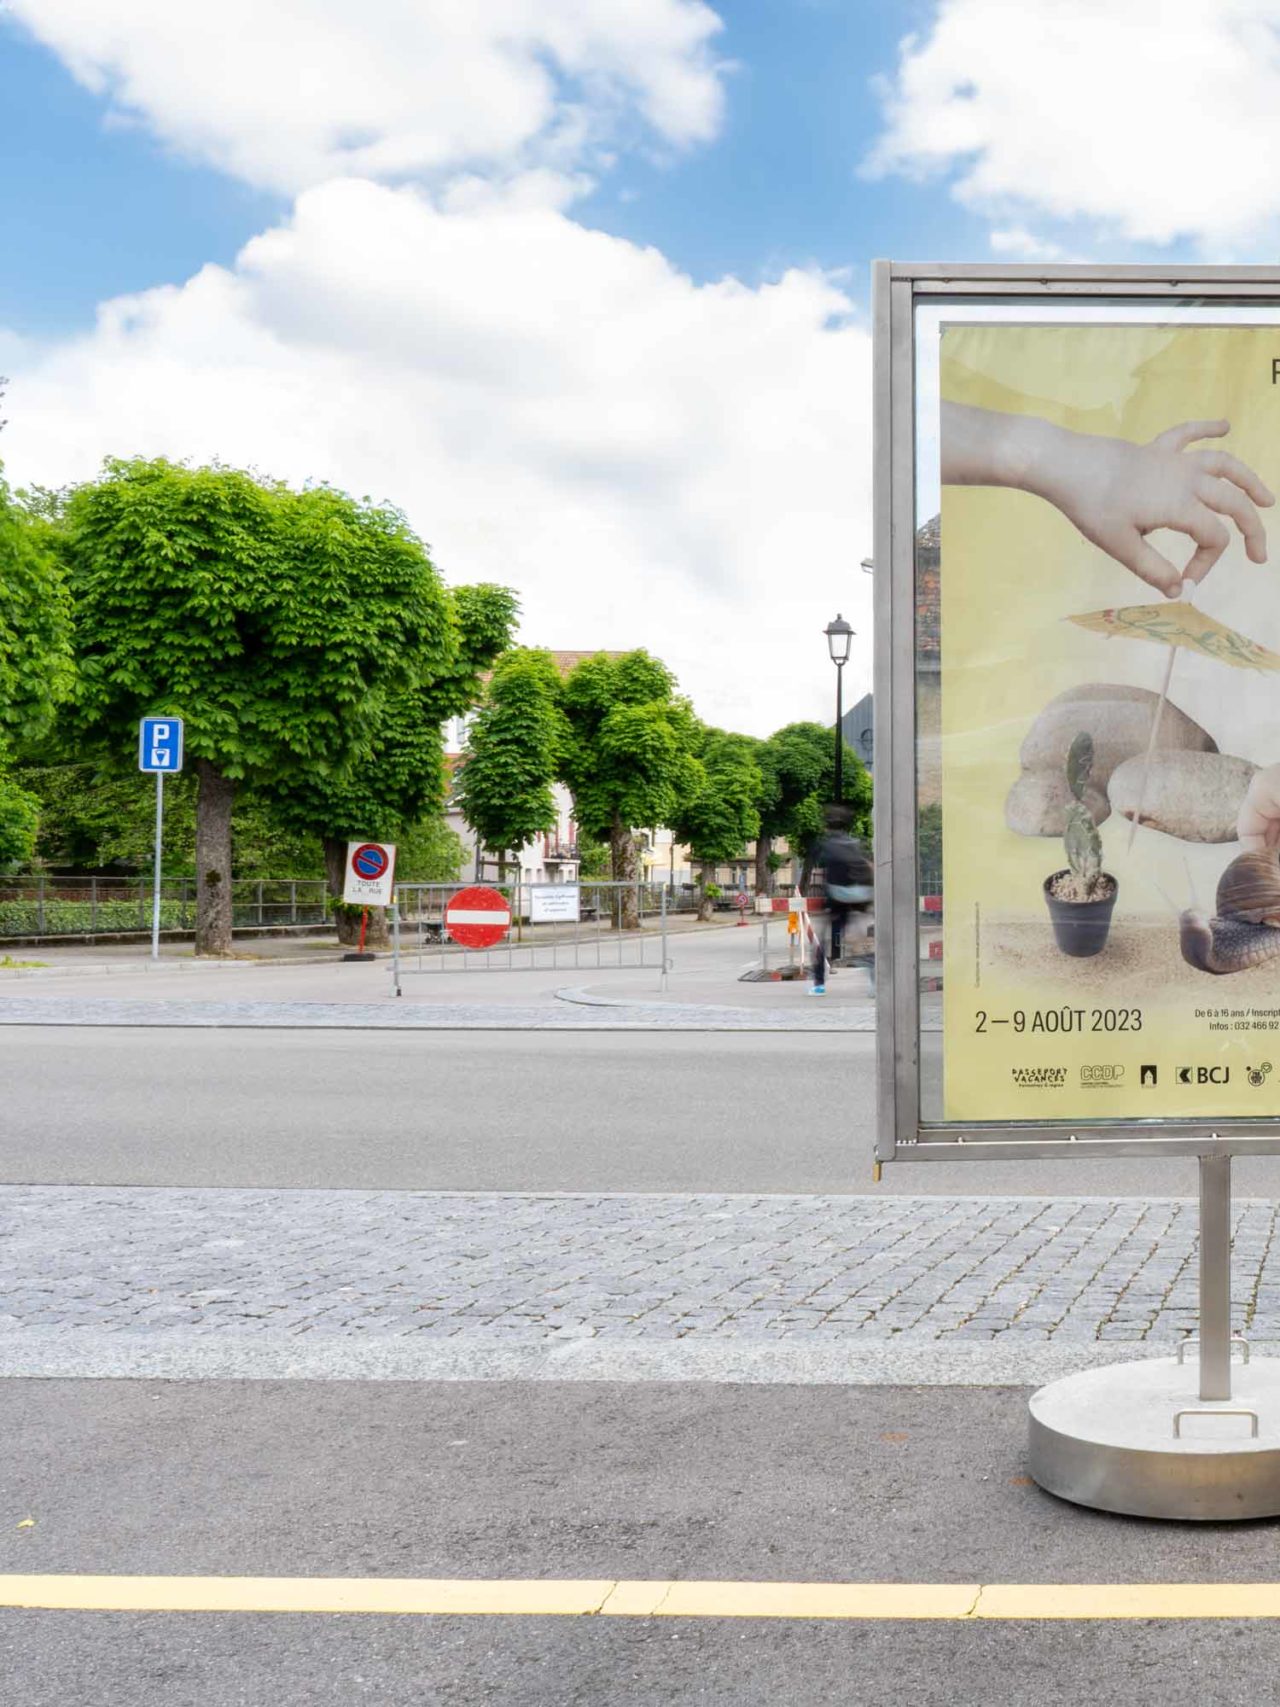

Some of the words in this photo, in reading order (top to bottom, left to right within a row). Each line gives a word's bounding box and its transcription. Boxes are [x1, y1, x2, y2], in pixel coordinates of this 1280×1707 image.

[153, 724, 170, 748] P
[1031, 1006, 1086, 1032] AOÛT
[1091, 1008, 1142, 1032] 2023
[1195, 1009, 1206, 1018] De
[1207, 1009, 1212, 1018] 6
[1214, 1009, 1219, 1017] à
[1221, 1009, 1229, 1017] 16
[1209, 1021, 1229, 1030] Infos
[1234, 1021, 1250, 1030] 032
[1268, 1021, 1279, 1030] 92
[1080, 1065, 1125, 1080] CCDP
[1197, 1066, 1229, 1084] BCJ
